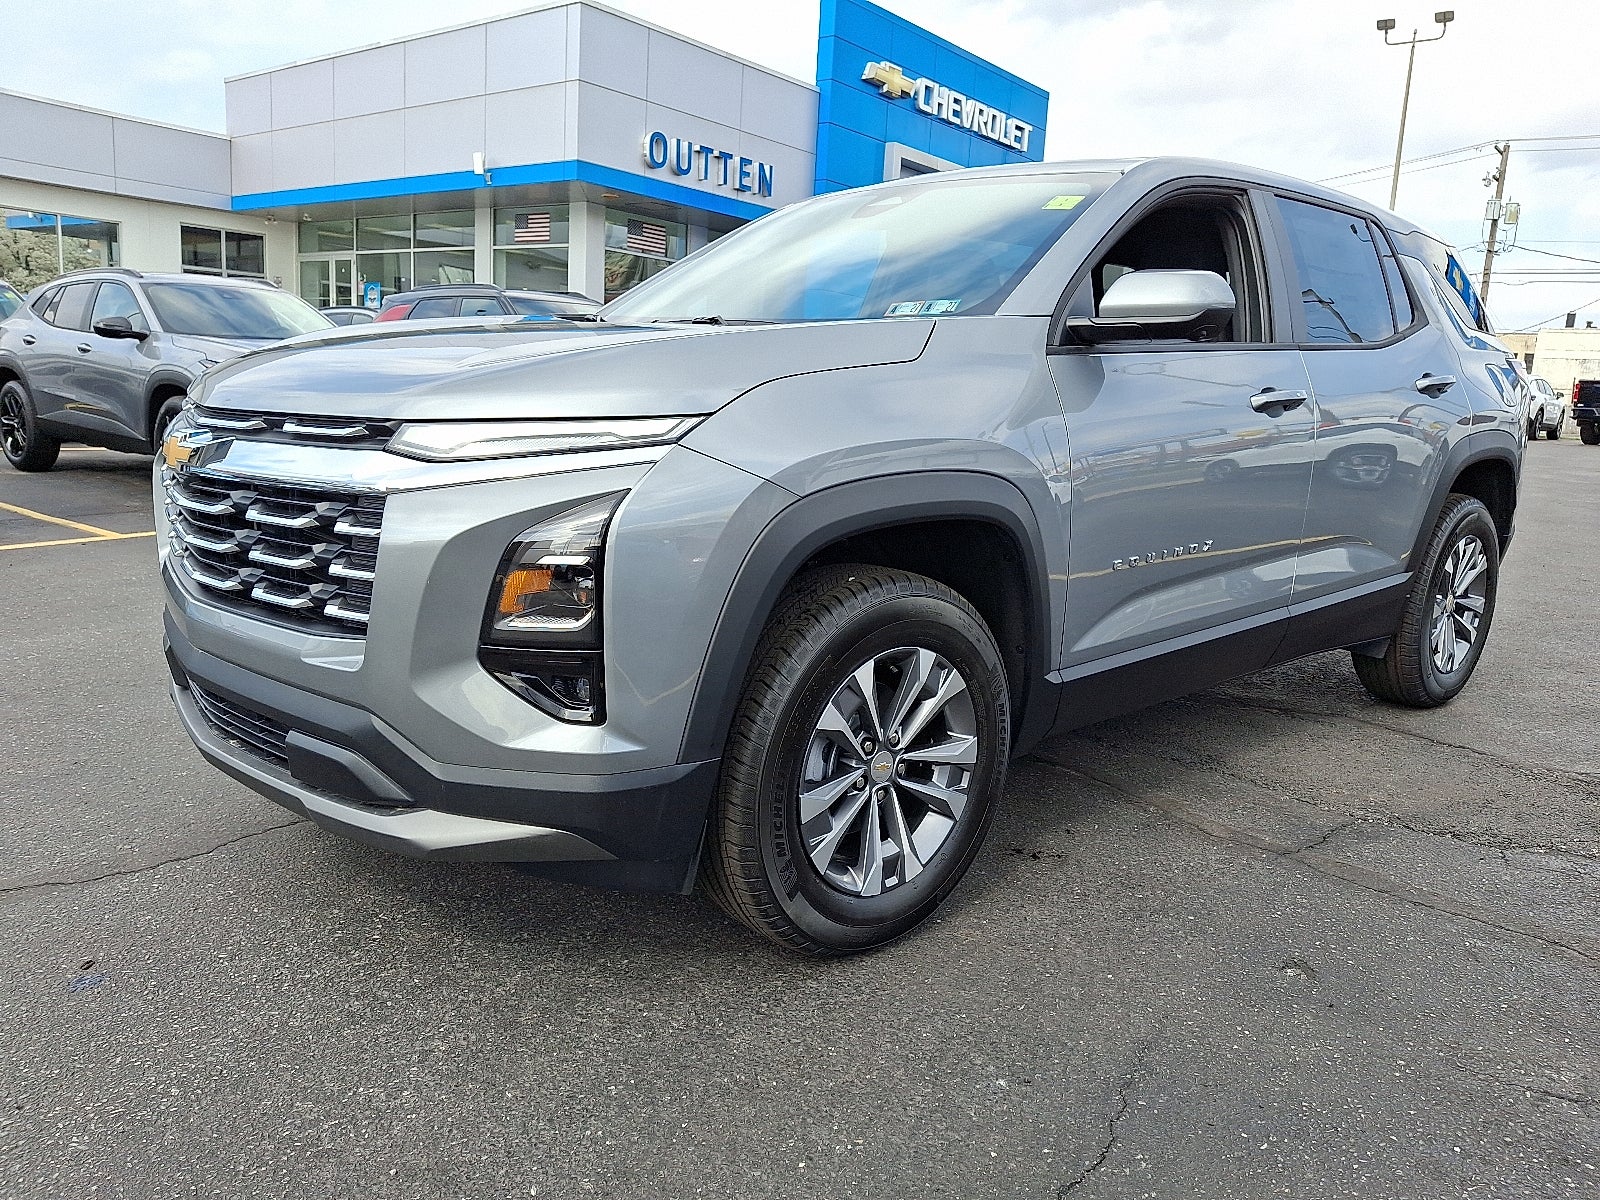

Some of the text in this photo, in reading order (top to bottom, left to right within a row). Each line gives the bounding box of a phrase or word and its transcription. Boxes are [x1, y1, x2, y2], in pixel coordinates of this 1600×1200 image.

[914, 77, 1033, 153] CHEVROLET
[643, 130, 774, 198] OUTTEN
[1112, 539, 1214, 571] EQUINOX
